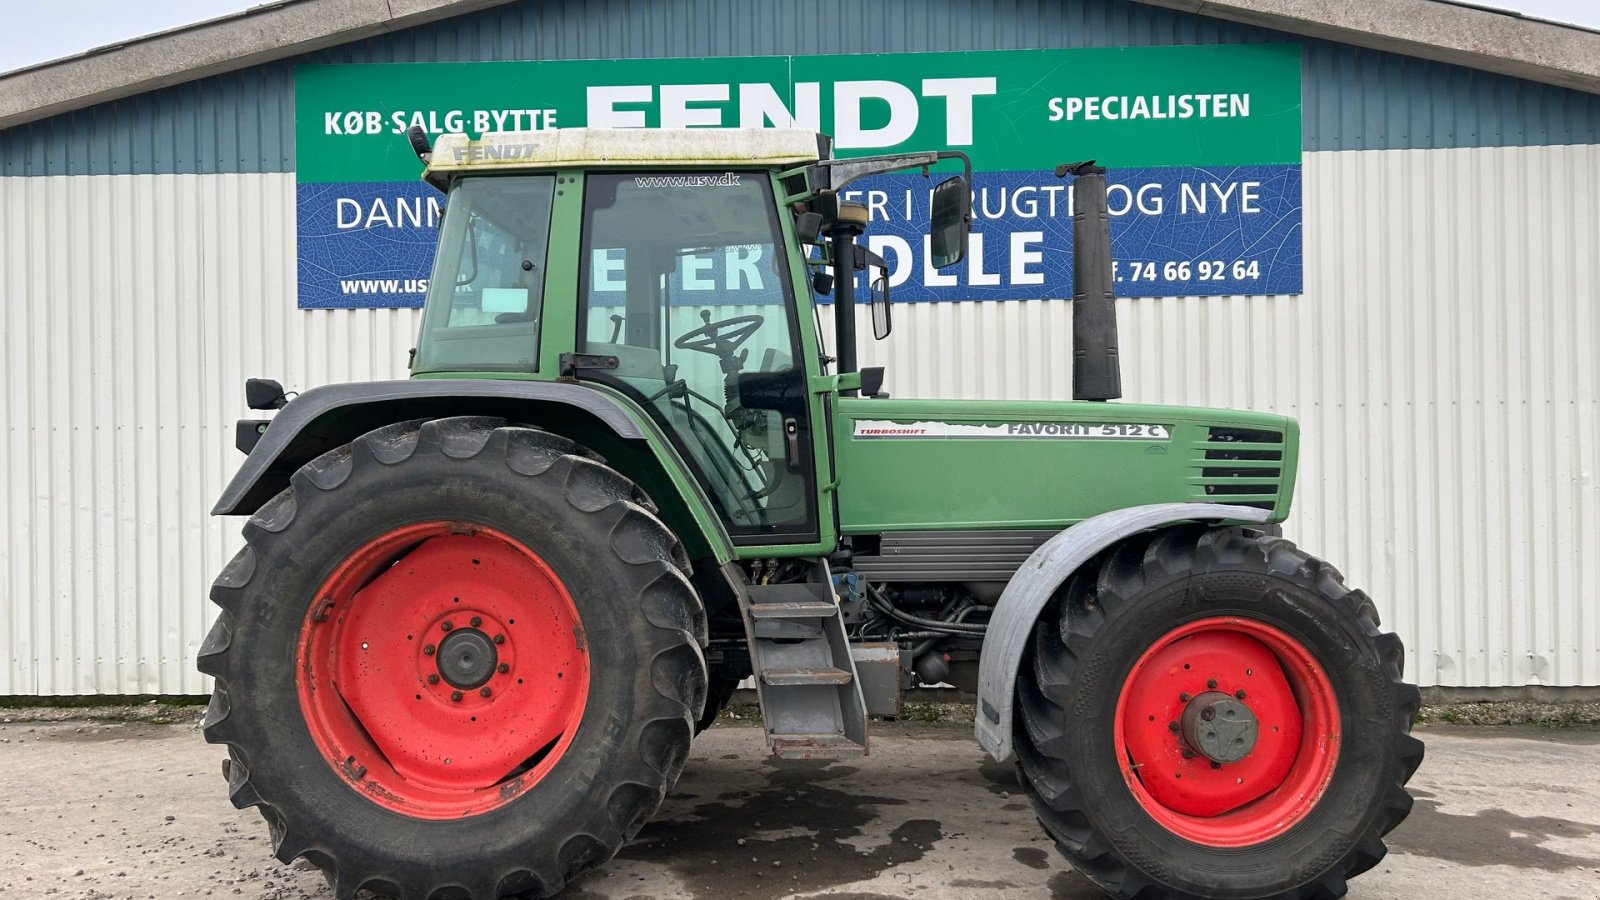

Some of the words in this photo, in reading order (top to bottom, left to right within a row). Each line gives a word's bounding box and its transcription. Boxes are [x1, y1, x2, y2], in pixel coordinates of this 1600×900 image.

[587, 77, 997, 149] FENDT
[1048, 93, 1250, 122] SPECIALISTEN
[452, 143, 541, 162] FENDT
[635, 172, 741, 188] www.usv.dk
[1105, 183, 1164, 216] OG
[1181, 181, 1261, 214] NYE
[1130, 261, 1157, 282] 74
[1164, 261, 1191, 281] 66
[1199, 260, 1226, 280] 92
[1233, 260, 1260, 280] 64
[860, 428, 927, 436] TURBOSHIFT
[1007, 423, 1092, 436] FAVORIT
[1102, 424, 1143, 437] 512
[1148, 425, 1159, 437] C
